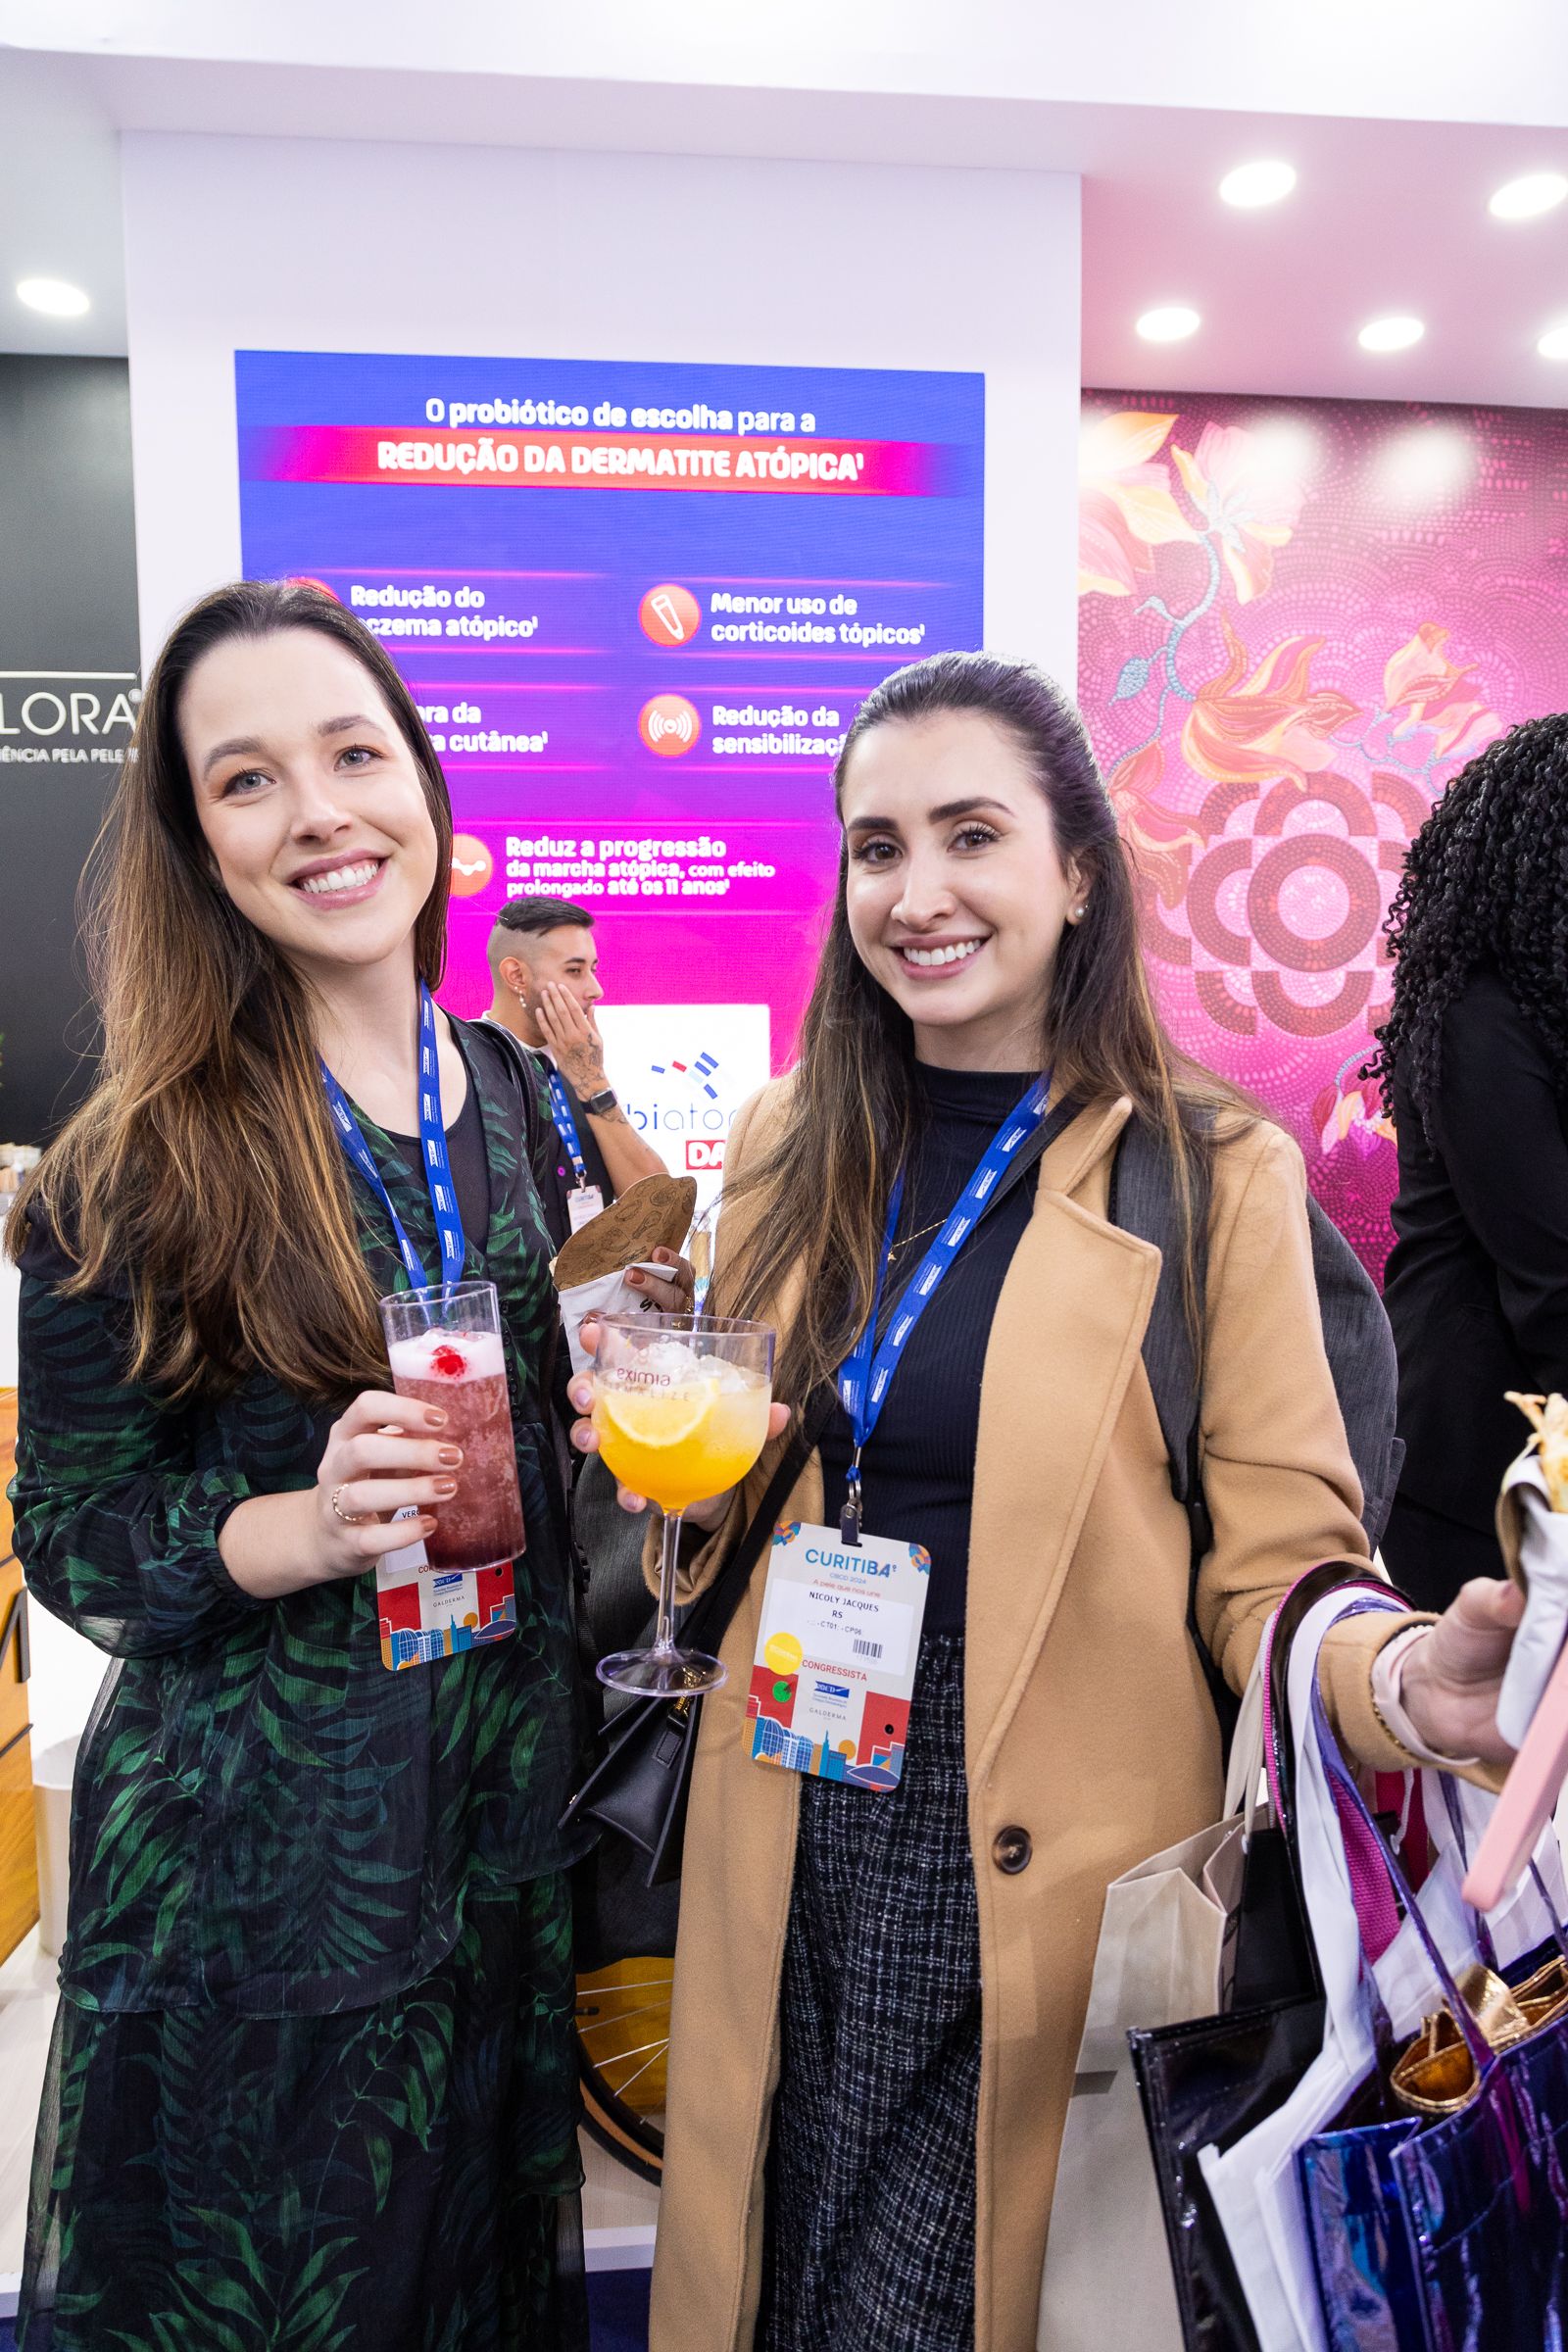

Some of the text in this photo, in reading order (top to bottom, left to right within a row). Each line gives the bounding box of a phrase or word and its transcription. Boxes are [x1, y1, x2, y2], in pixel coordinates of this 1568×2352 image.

[425, 397, 816, 436] O probiótico de escolha para a
[377, 437, 519, 475] REDUÇÃO
[523, 445, 566, 473] DA
[570, 446, 731, 477] DERMATITE
[350, 585, 485, 609] Redução do
[710, 592, 858, 615] Menor uso de
[711, 620, 836, 643] corticoides
[452, 702, 481, 723] da
[712, 705, 840, 728] Redução da
[52, 748, 89, 763] PELA
[91, 748, 124, 763] PELE
[506, 836, 727, 861] Reduz a progressão
[506, 859, 775, 881] da marcha atópica, com efeito
[508, 878, 604, 898] prolongado
[607, 878, 638, 895] até
[641, 879, 663, 895] os
[665, 879, 679, 895] 11
[616, 1368, 670, 1387] eximia
[805, 1548, 891, 1579] CURITIBA
[808, 1591, 880, 1613] NICOLY JACQUES
[831, 1609, 843, 1619] RS
[802, 1659, 867, 1682] CONGRESSISTA
[808, 1707, 847, 1721] GALDERMA
